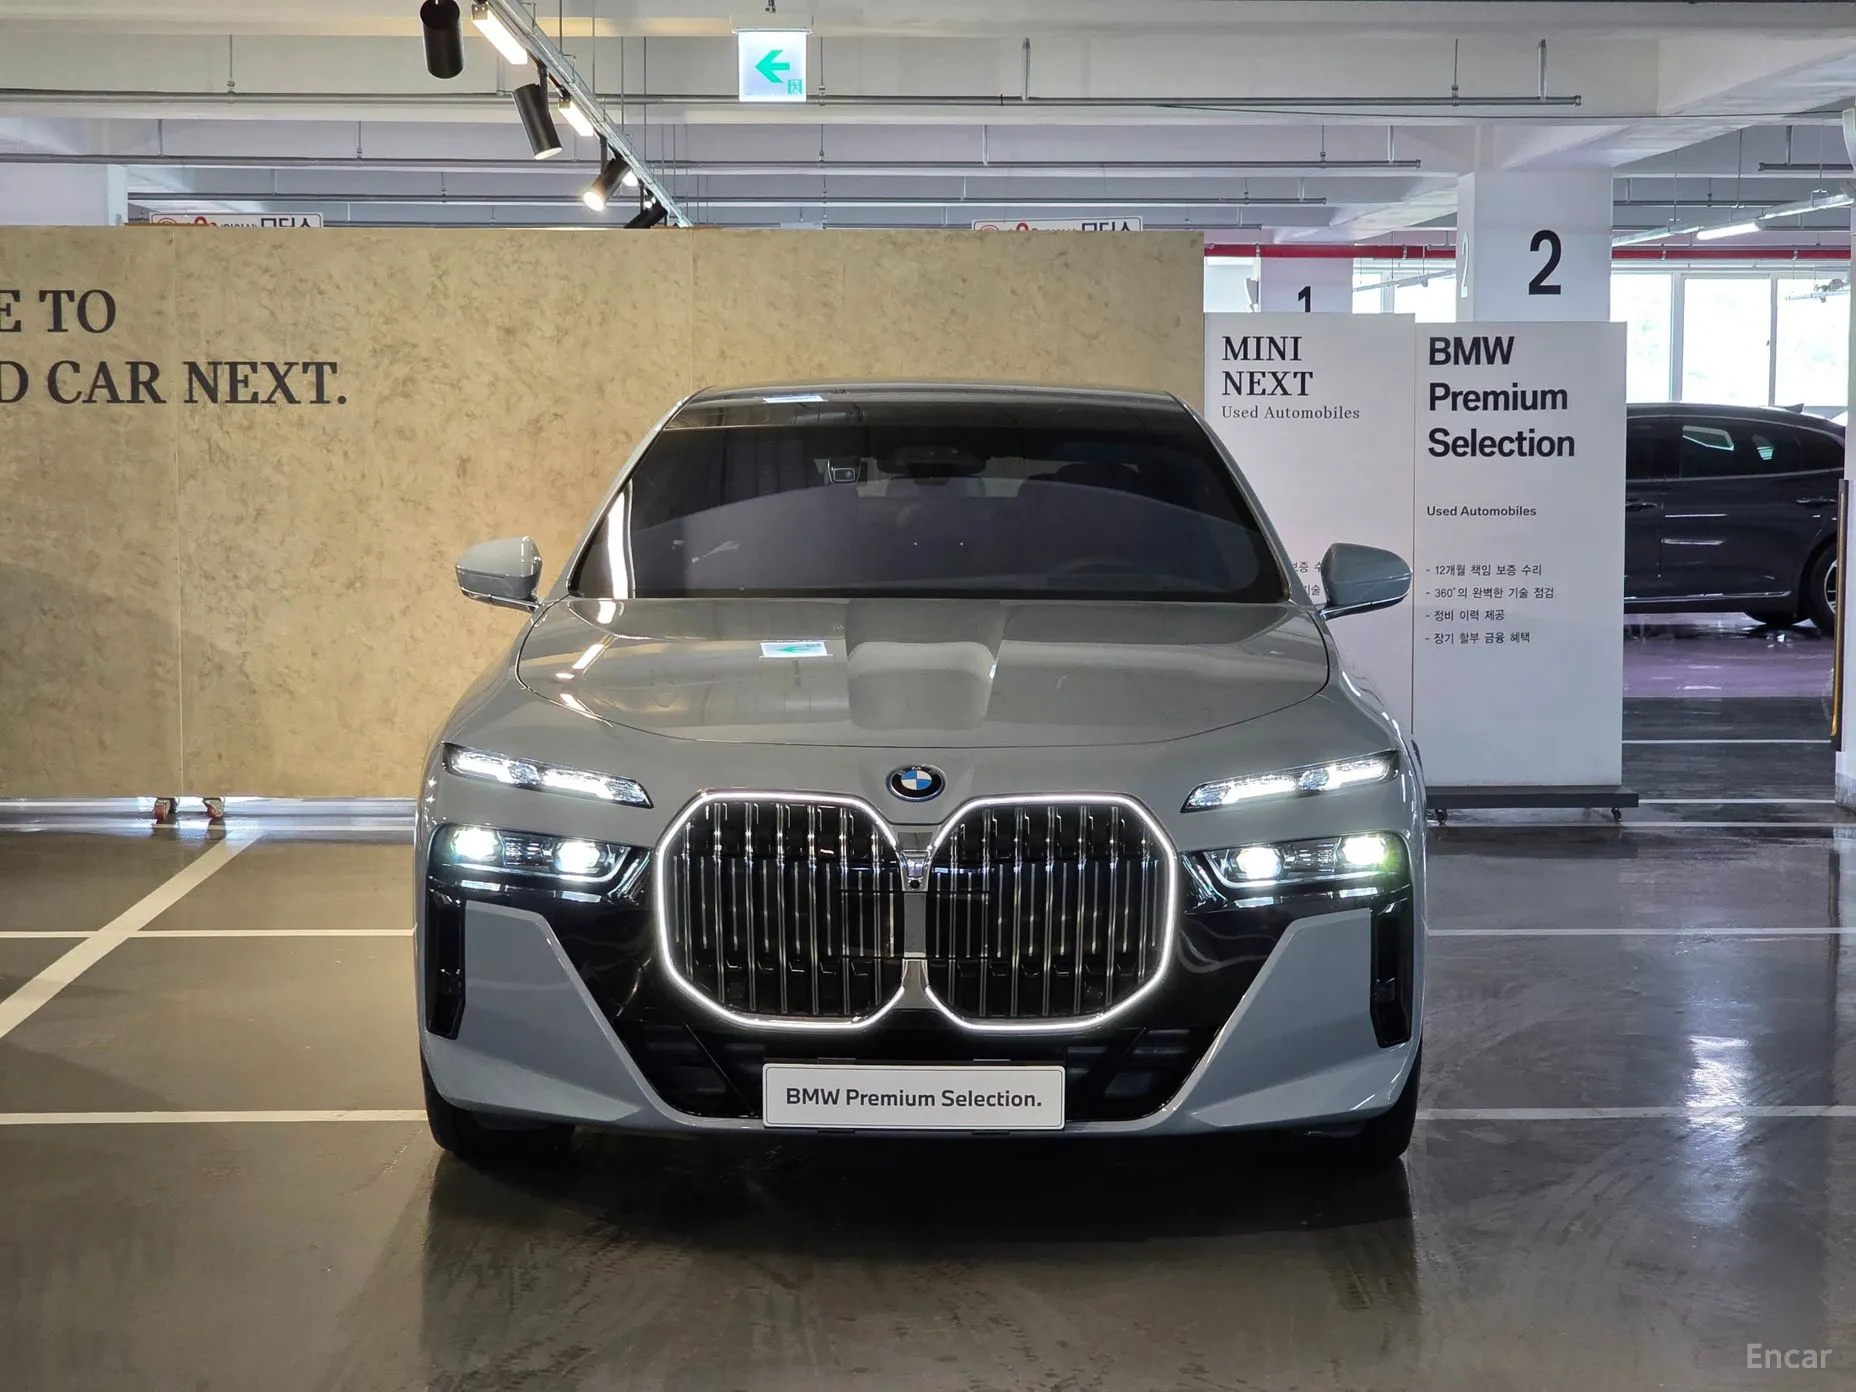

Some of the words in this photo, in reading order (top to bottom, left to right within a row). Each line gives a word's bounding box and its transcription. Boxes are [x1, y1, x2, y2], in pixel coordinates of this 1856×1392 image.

[1528, 229, 1562, 296] 2
[38, 288, 117, 334] TO
[1221, 335, 1304, 362] MINI
[1427, 336, 1516, 366] BMW
[47, 360, 168, 405] CAR
[182, 361, 348, 405] NEXT.
[1221, 370, 1315, 397] NEXT
[1427, 381, 1569, 412] Premium
[1220, 404, 1260, 420] Used
[1262, 404, 1361, 420] Automobiles
[1427, 426, 1576, 458] Selection
[1426, 505, 1458, 517] Used
[1459, 505, 1538, 517] Automobiles
[1435, 563, 1466, 577] 12개월
[1470, 563, 1492, 577] 책임
[1496, 563, 1518, 577] 보증
[1521, 563, 1543, 577] 수리
[1472, 586, 1504, 600] 완벽한
[1508, 586, 1529, 600] 기술
[1533, 586, 1555, 600] 점검
[1433, 609, 1455, 622] 정비
[1459, 608, 1480, 622] 이력
[1484, 608, 1506, 621] 제공
[1433, 632, 1455, 645] 장기
[1459, 631, 1480, 645] 할부
[1484, 631, 1506, 645] 금융
[1509, 631, 1531, 644] 혜택
[785, 1086, 841, 1106] BMW
[845, 1087, 936, 1108] Premium
[940, 1088, 1043, 1109] Selection.
